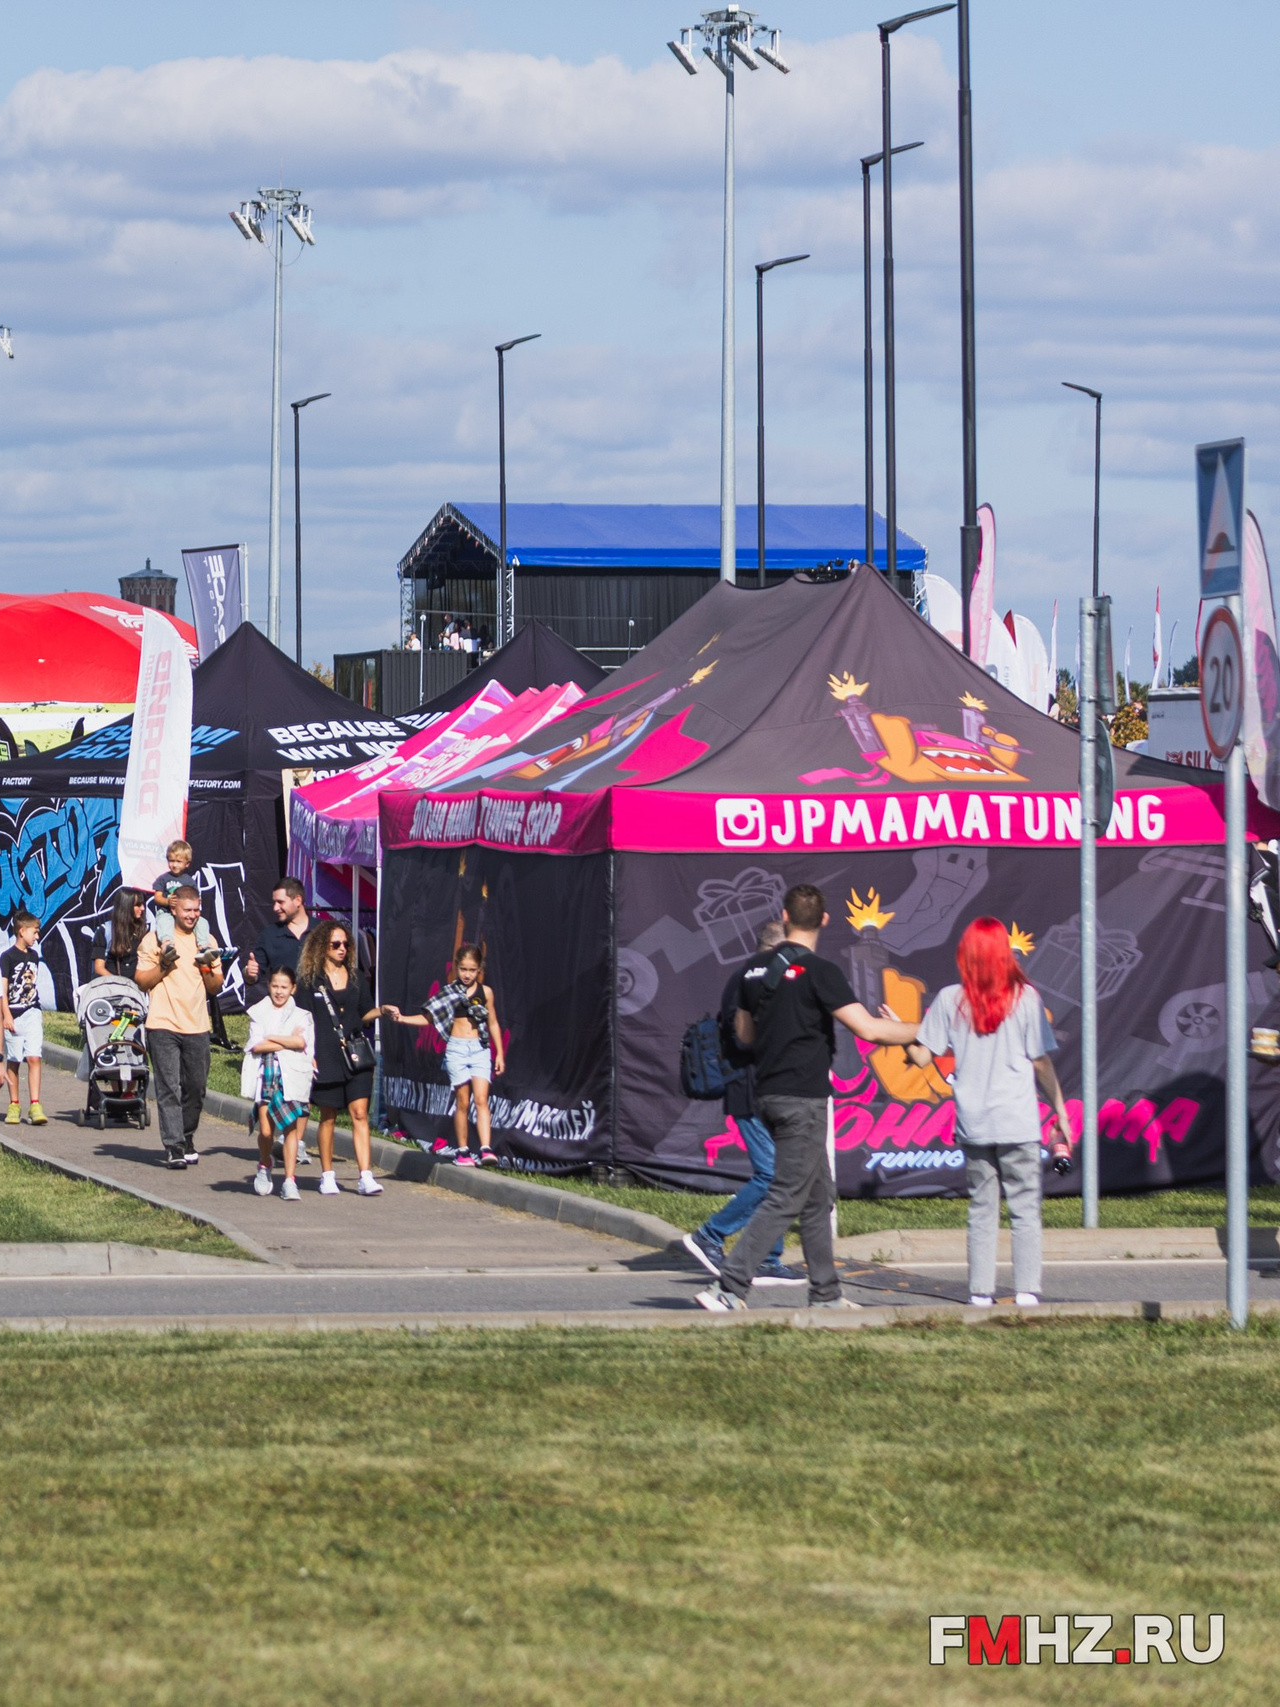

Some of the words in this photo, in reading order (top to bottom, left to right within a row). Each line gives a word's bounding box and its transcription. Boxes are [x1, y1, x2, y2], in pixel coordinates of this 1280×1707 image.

[1210, 654, 1233, 714] 20
[267, 720, 407, 745] BECAUSE
[276, 743, 352, 762] WHY
[355, 740, 406, 757] NO
[2, 777, 32, 786] FACTORY
[69, 776, 98, 785] BECAUSE
[99, 776, 115, 785] WHY
[115, 776, 126, 785] NO
[523, 800, 562, 846] SHOP
[771, 793, 1166, 845] JPMAMATUNNG
[866, 1150, 966, 1170] TUNING
